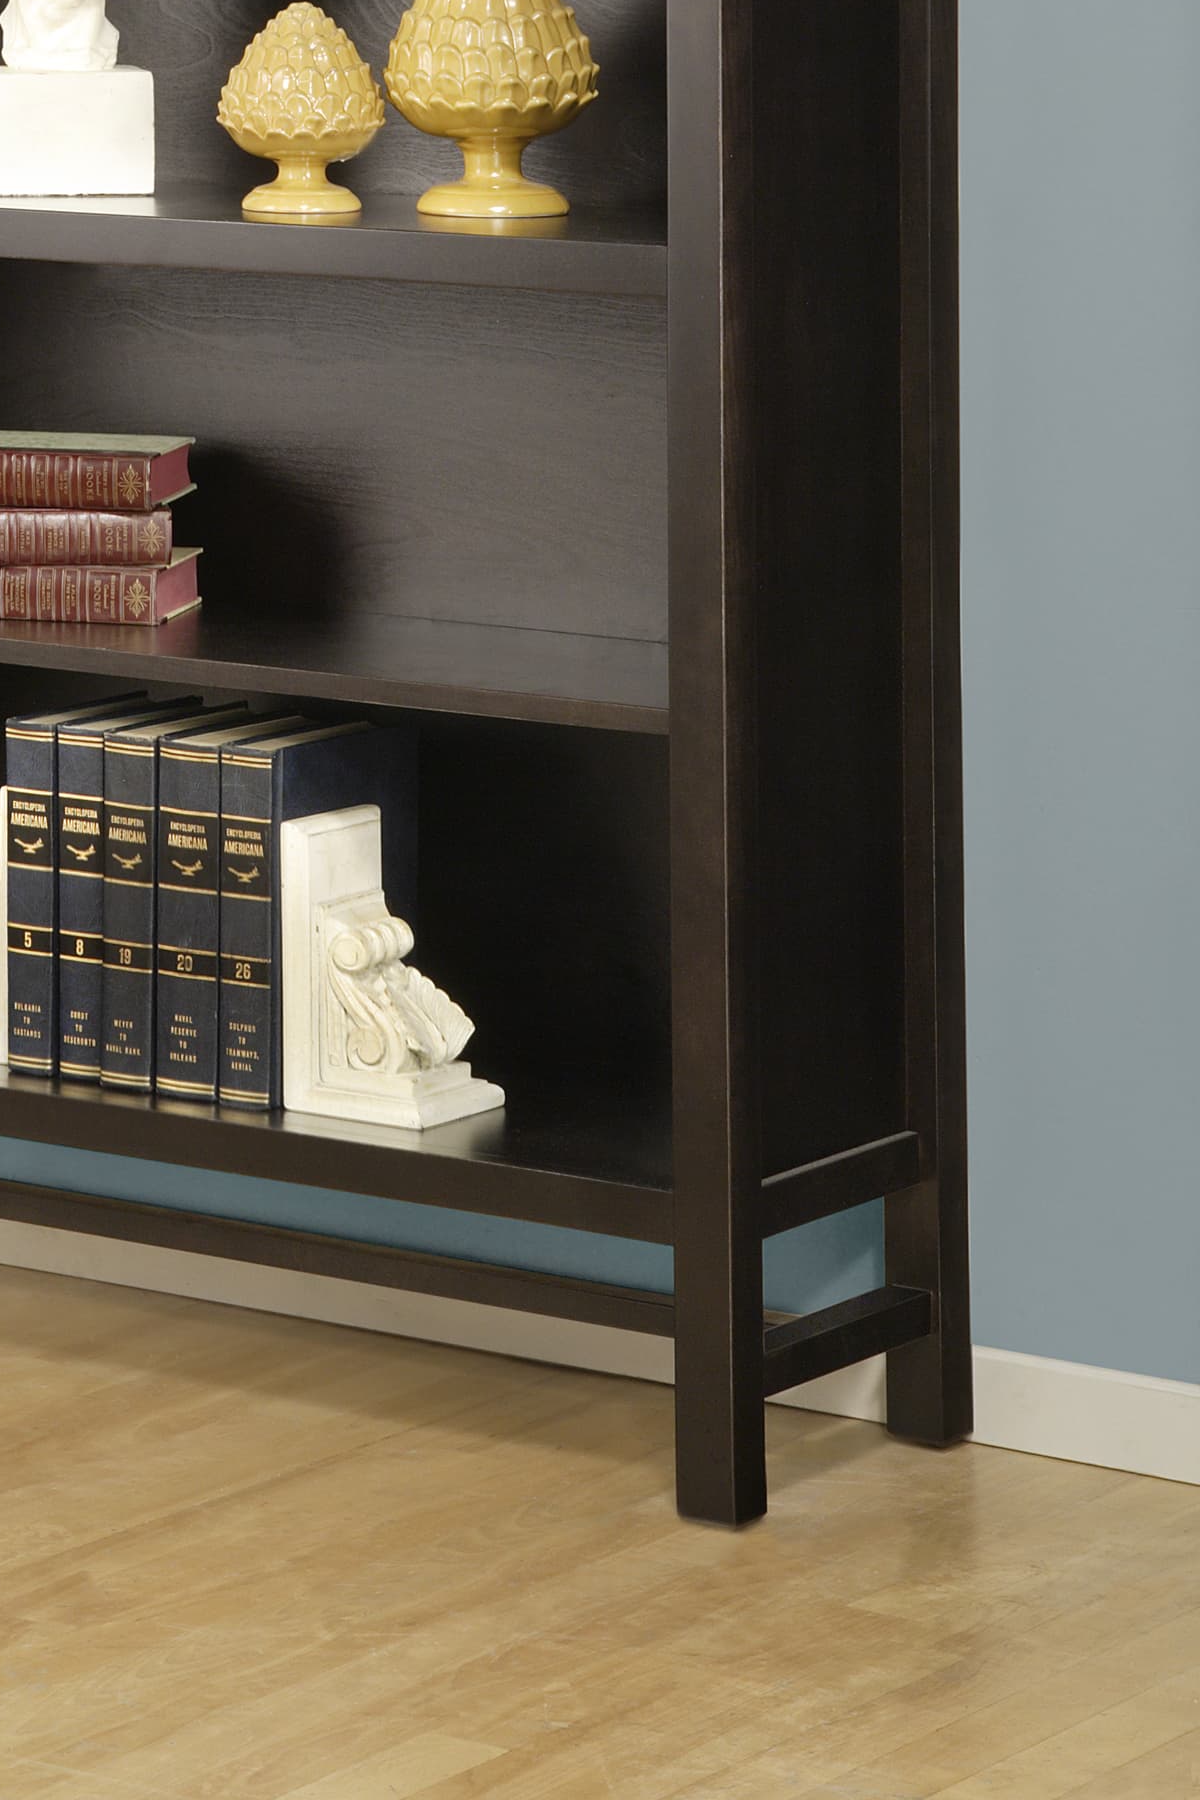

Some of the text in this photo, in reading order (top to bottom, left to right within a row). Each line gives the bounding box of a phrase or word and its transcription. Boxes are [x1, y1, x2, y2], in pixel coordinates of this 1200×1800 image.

[10, 812, 48, 829] AMERICANA
[62, 818, 100, 835] AMERICANA
[108, 827, 147, 844] AMERICANA
[167, 833, 208, 851] AMERICANA
[224, 840, 264, 857] AMERICANA
[24, 931, 32, 948] 5
[75, 939, 84, 956] 8
[119, 947, 132, 965] 19
[176, 954, 193, 972] 20
[235, 962, 251, 980] 26
[174, 1014, 193, 1024] NAVAL
[75, 1023, 83, 1033] TO
[179, 1040, 187, 1049] TO
